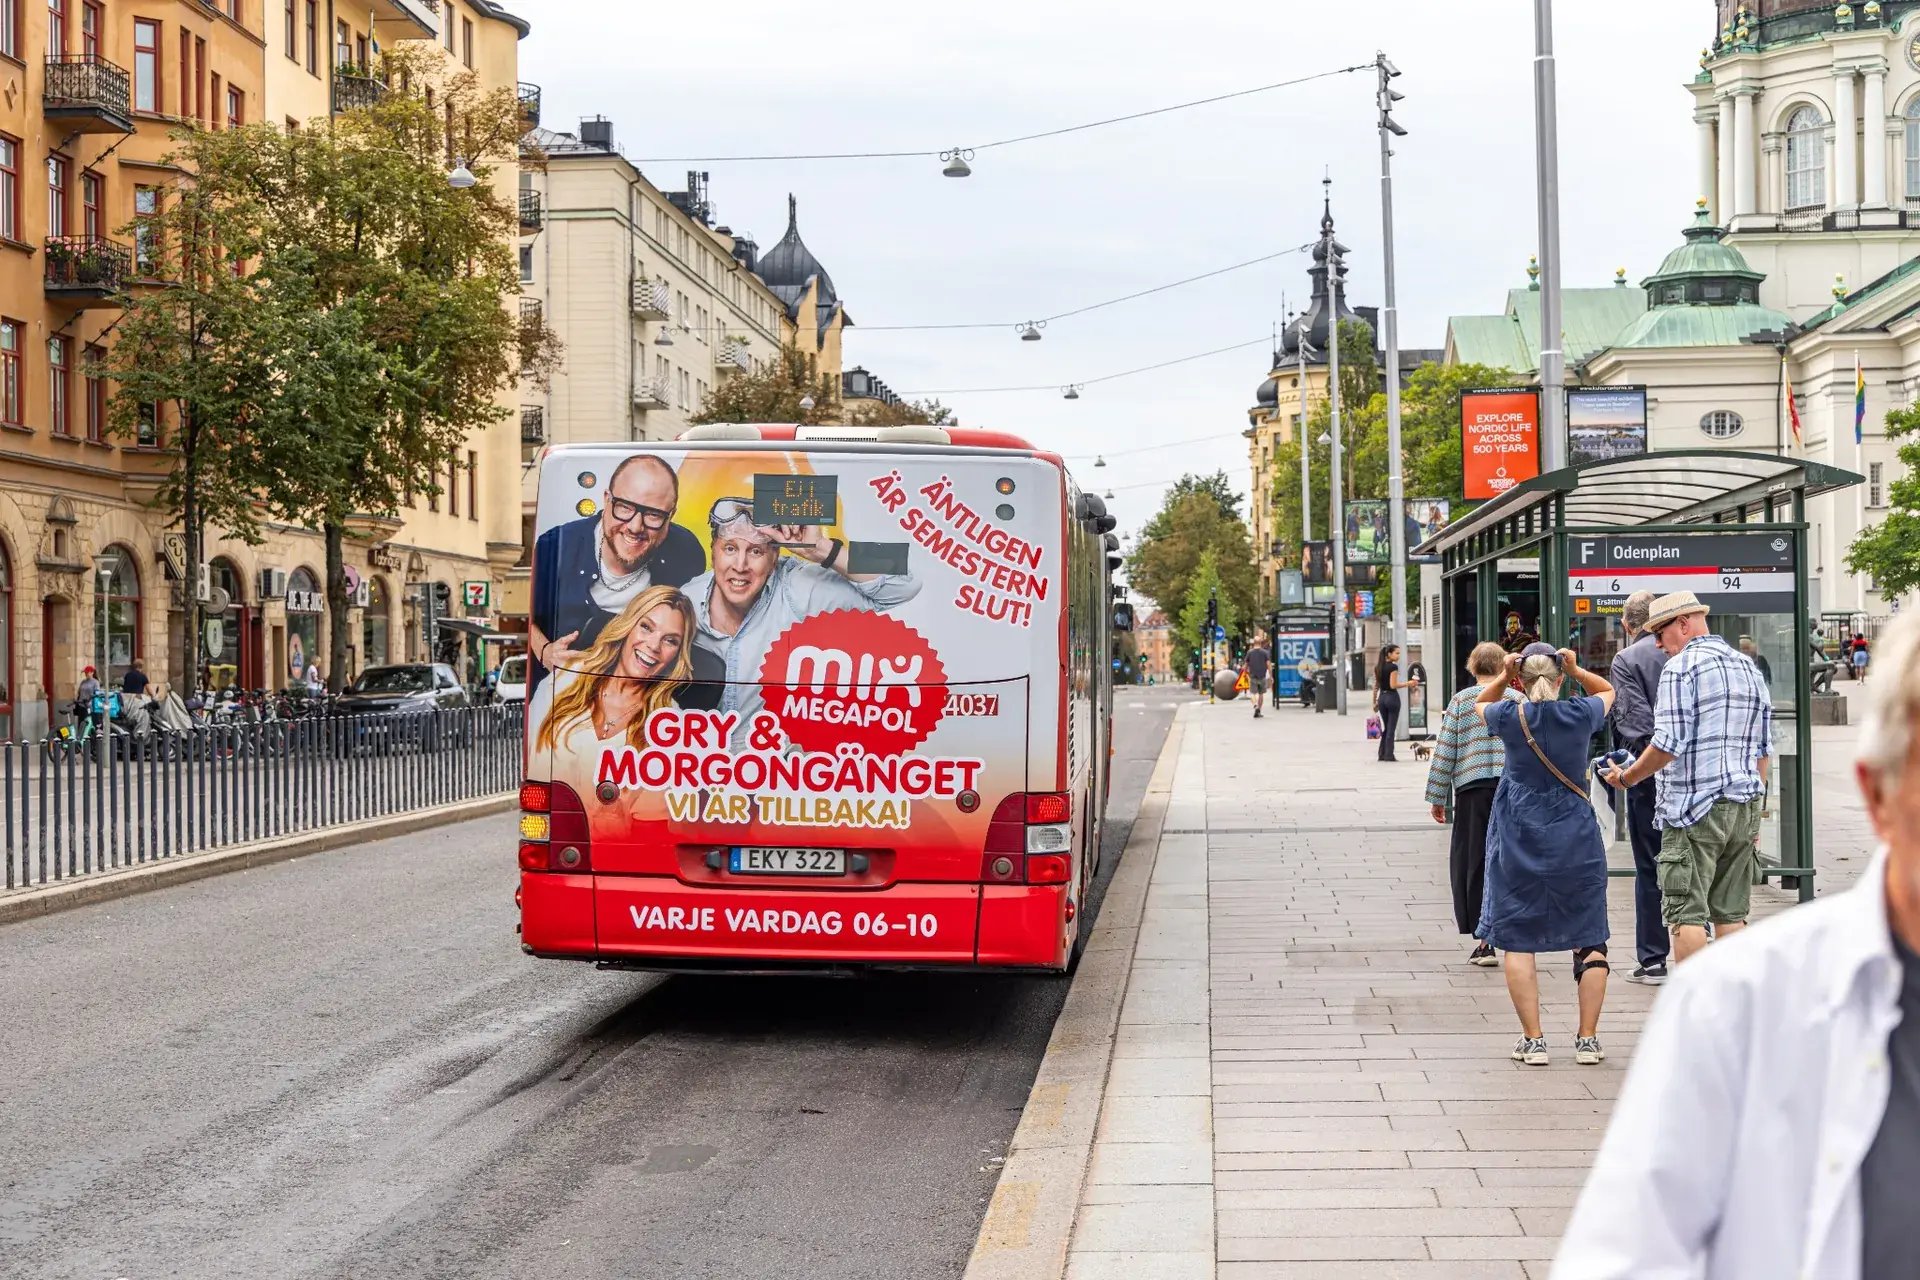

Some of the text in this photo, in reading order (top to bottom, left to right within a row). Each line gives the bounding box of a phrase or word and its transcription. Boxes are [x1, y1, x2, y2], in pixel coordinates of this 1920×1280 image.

[1468, 423, 1532, 433] NORDIC LIFE
[1476, 413, 1523, 423] EXPLORE
[1473, 443, 1529, 454] 500 YEARS
[1479, 434, 1522, 443] ACROSS
[772, 498, 825, 517] trafik
[920, 475, 1043, 570] ÄNTLIGEN
[869, 470, 1048, 601] ÄR SEMESTERN
[168, 537, 186, 567] GUL
[1581, 542, 1680, 564] F Odenplan
[1575, 580, 1584, 593] 4
[1611, 579, 1621, 592] 6
[1722, 576, 1742, 590] 94
[955, 584, 1032, 627] SLUT!
[1280, 640, 1318, 660] REA
[782, 694, 918, 734] MEGAPOL
[944, 694, 998, 717] 4037
[649, 712, 781, 751] GRY &
[598, 746, 982, 796] MORGONGÄNGET
[667, 786, 908, 826] VI ÄR TILLBAKA!
[748, 849, 836, 870] EKY 322
[629, 905, 715, 931] VARJE
[724, 908, 843, 935] VARDAG
